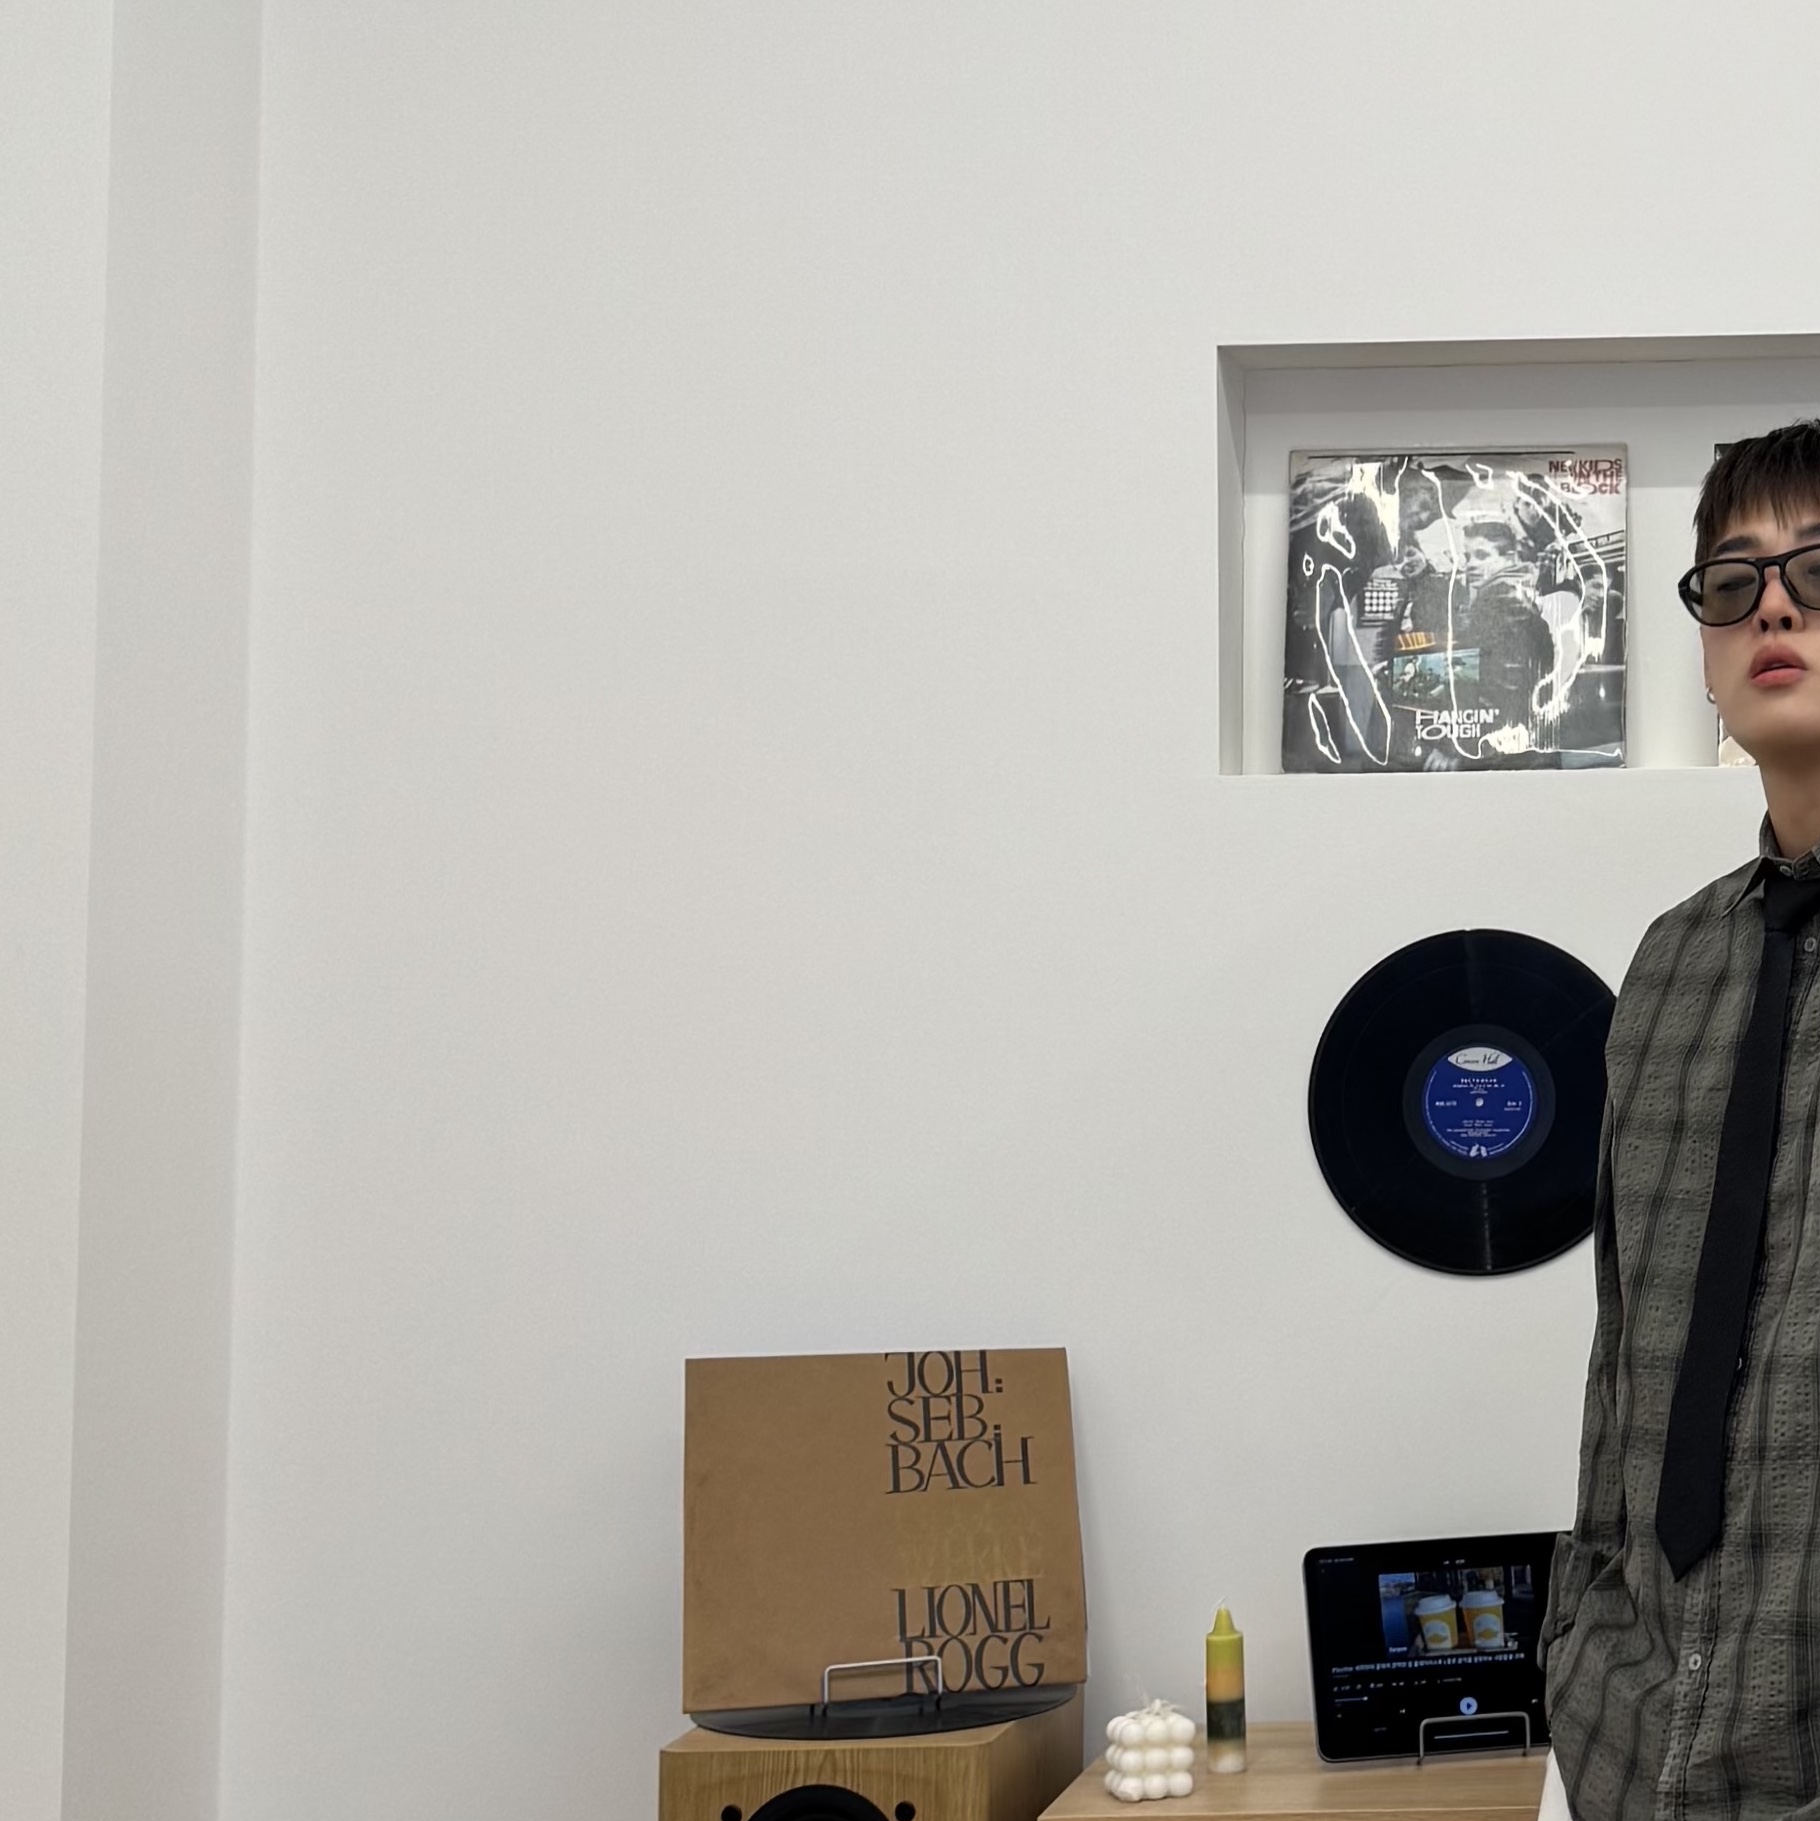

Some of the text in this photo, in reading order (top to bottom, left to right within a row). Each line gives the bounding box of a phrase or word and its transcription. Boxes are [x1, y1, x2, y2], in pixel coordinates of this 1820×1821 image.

[885, 1436, 1038, 1495] BACH
[890, 1578, 1051, 1641] LIONEL
[901, 1632, 1046, 1694] ROGG
